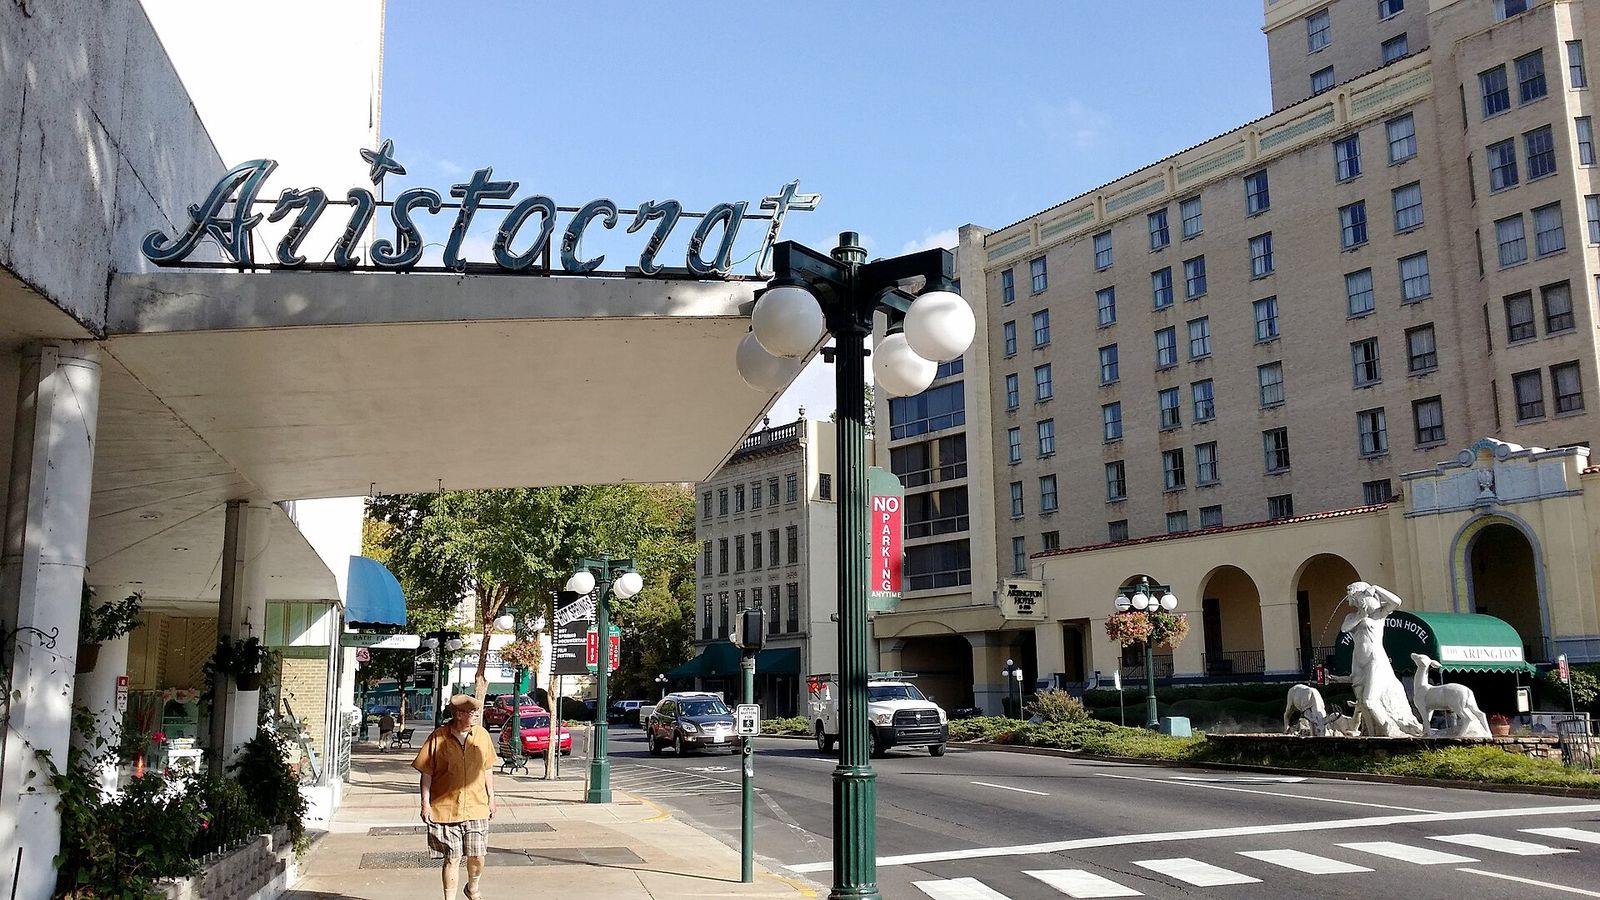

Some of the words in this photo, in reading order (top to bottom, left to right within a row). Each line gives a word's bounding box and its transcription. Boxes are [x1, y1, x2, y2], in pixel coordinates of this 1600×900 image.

[142, 138, 820, 279] Aristocrat
[874, 497, 899, 512] NO
[882, 513, 891, 591] PARKING
[1007, 589, 1043, 597] ARLINGTON
[556, 608, 571, 625] HOT
[567, 597, 593, 619] SPRINGS
[1341, 631, 1354, 646] TH
[1404, 620, 1428, 644] HOTEL
